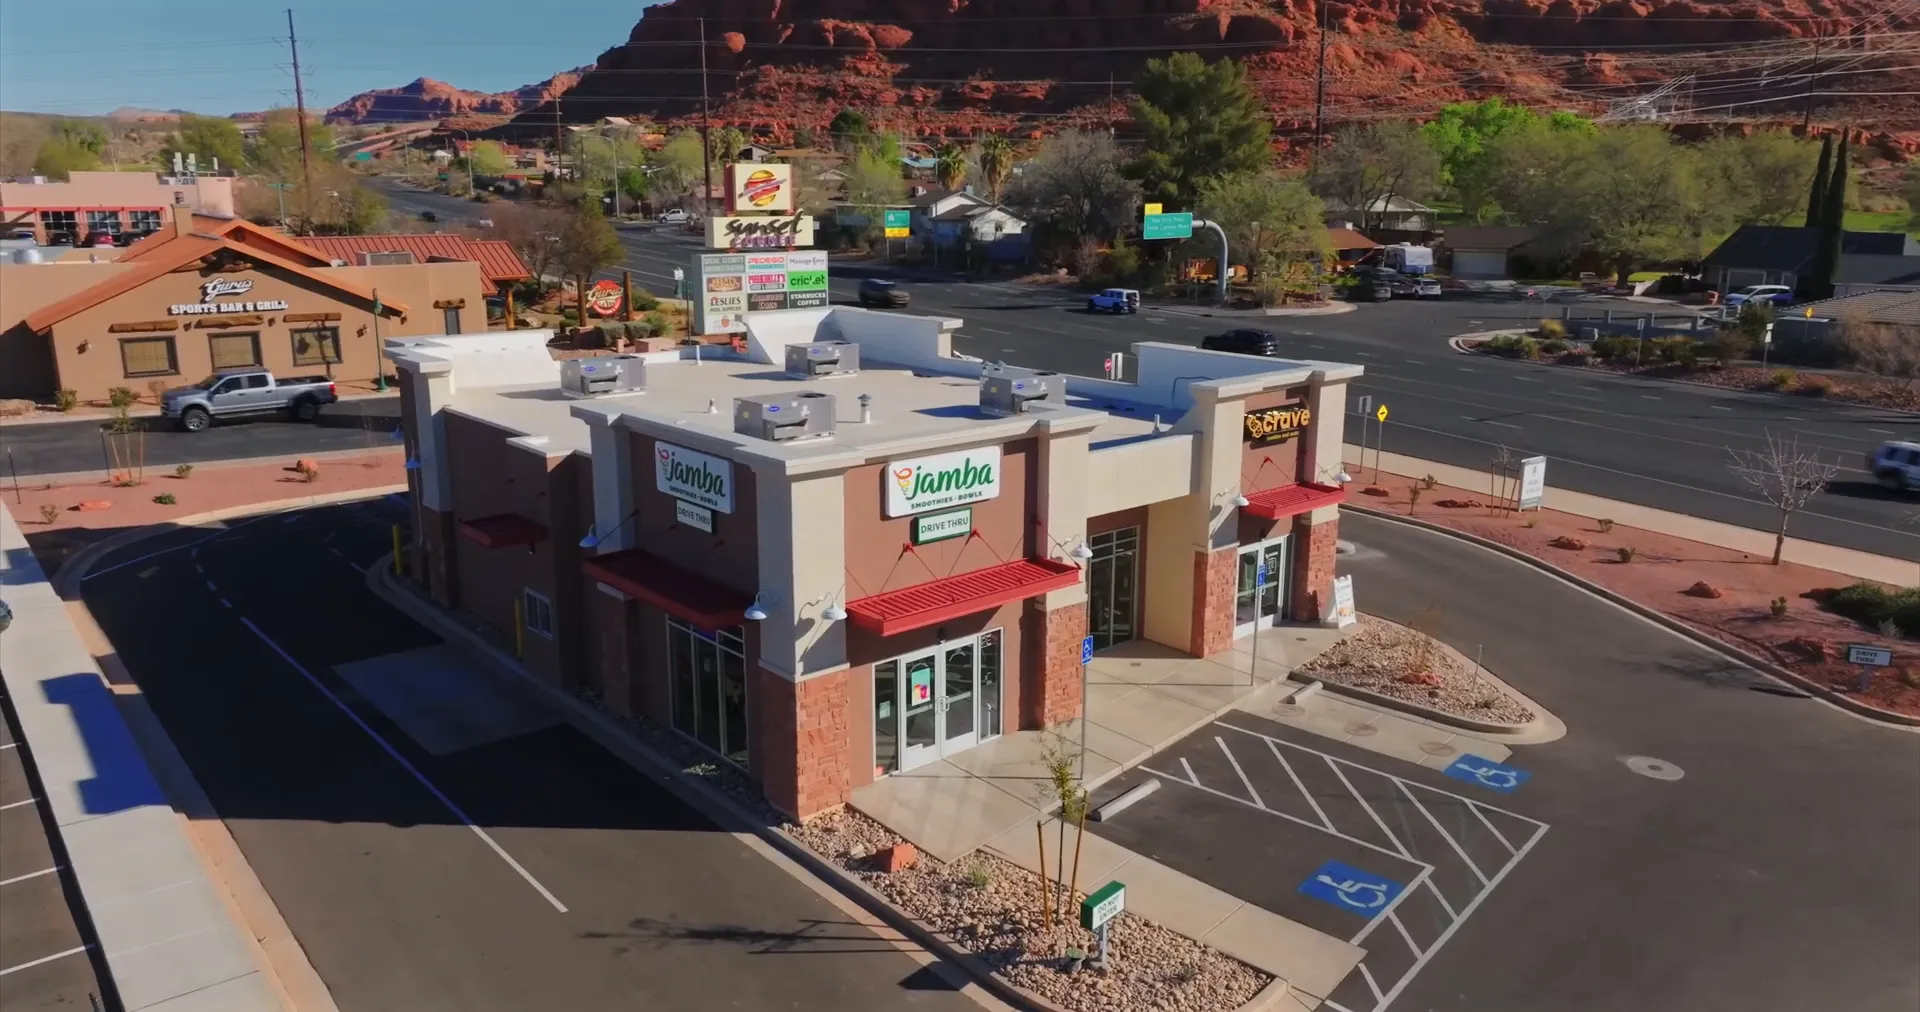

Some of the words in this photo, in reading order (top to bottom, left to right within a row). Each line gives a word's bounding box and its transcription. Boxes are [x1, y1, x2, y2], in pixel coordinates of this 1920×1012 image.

[748, 256, 785, 264] PEDEGO
[790, 274, 826, 286] cricket
[171, 303, 218, 315] SPORTS
[220, 302, 244, 312] BAR
[246, 301, 255, 311] &
[256, 300, 288, 310] GRILL
[1263, 408, 1311, 433] crave
[666, 451, 726, 498] jamba
[905, 457, 994, 500] jamba
[911, 496, 953, 509] SMOOTHIES
[958, 491, 983, 502] BOWLS
[677, 507, 695, 520] DRIVE
[695, 513, 711, 526] THRU
[920, 521, 946, 534] DRIVE
[948, 517, 969, 529] THRU
[1855, 650, 1878, 658] DRIVE
